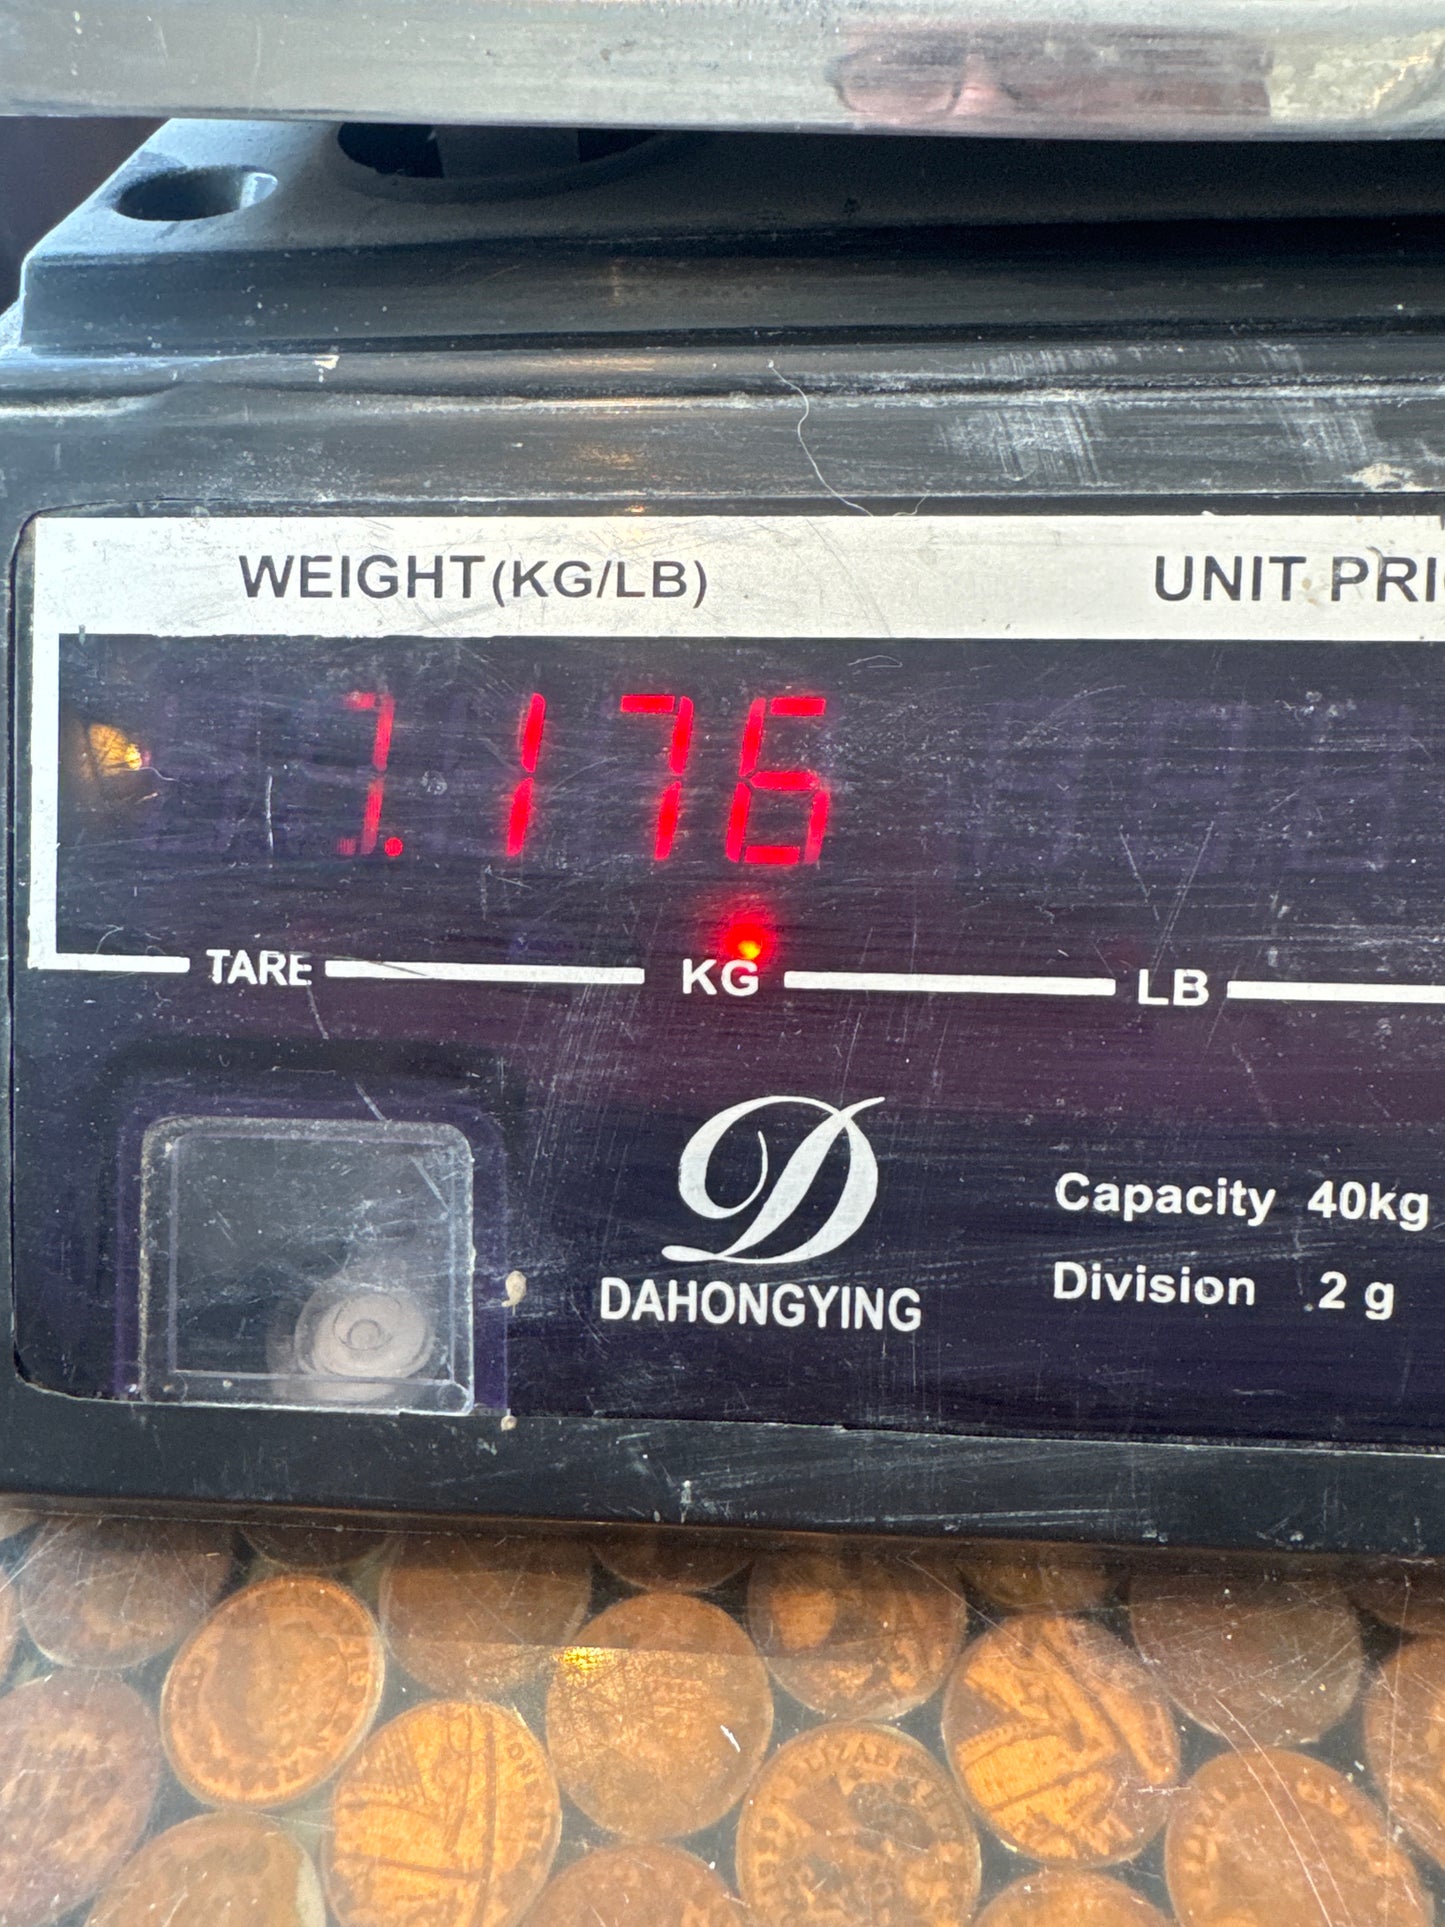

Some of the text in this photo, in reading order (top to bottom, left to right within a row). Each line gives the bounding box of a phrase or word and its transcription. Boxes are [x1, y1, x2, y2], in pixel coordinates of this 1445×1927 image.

[239, 555, 707, 607] WEIGHT(KG/LB)
[1155, 556, 1445, 602] UNIT PRI
[205, 949, 312, 986] TARE
[682, 958, 759, 996] KG
[1137, 968, 1210, 1007] LB
[1054, 1172, 1430, 1232] Capacity 40kg
[600, 1277, 921, 1332] DAHONGYING
[1053, 1261, 1255, 1306] Division
